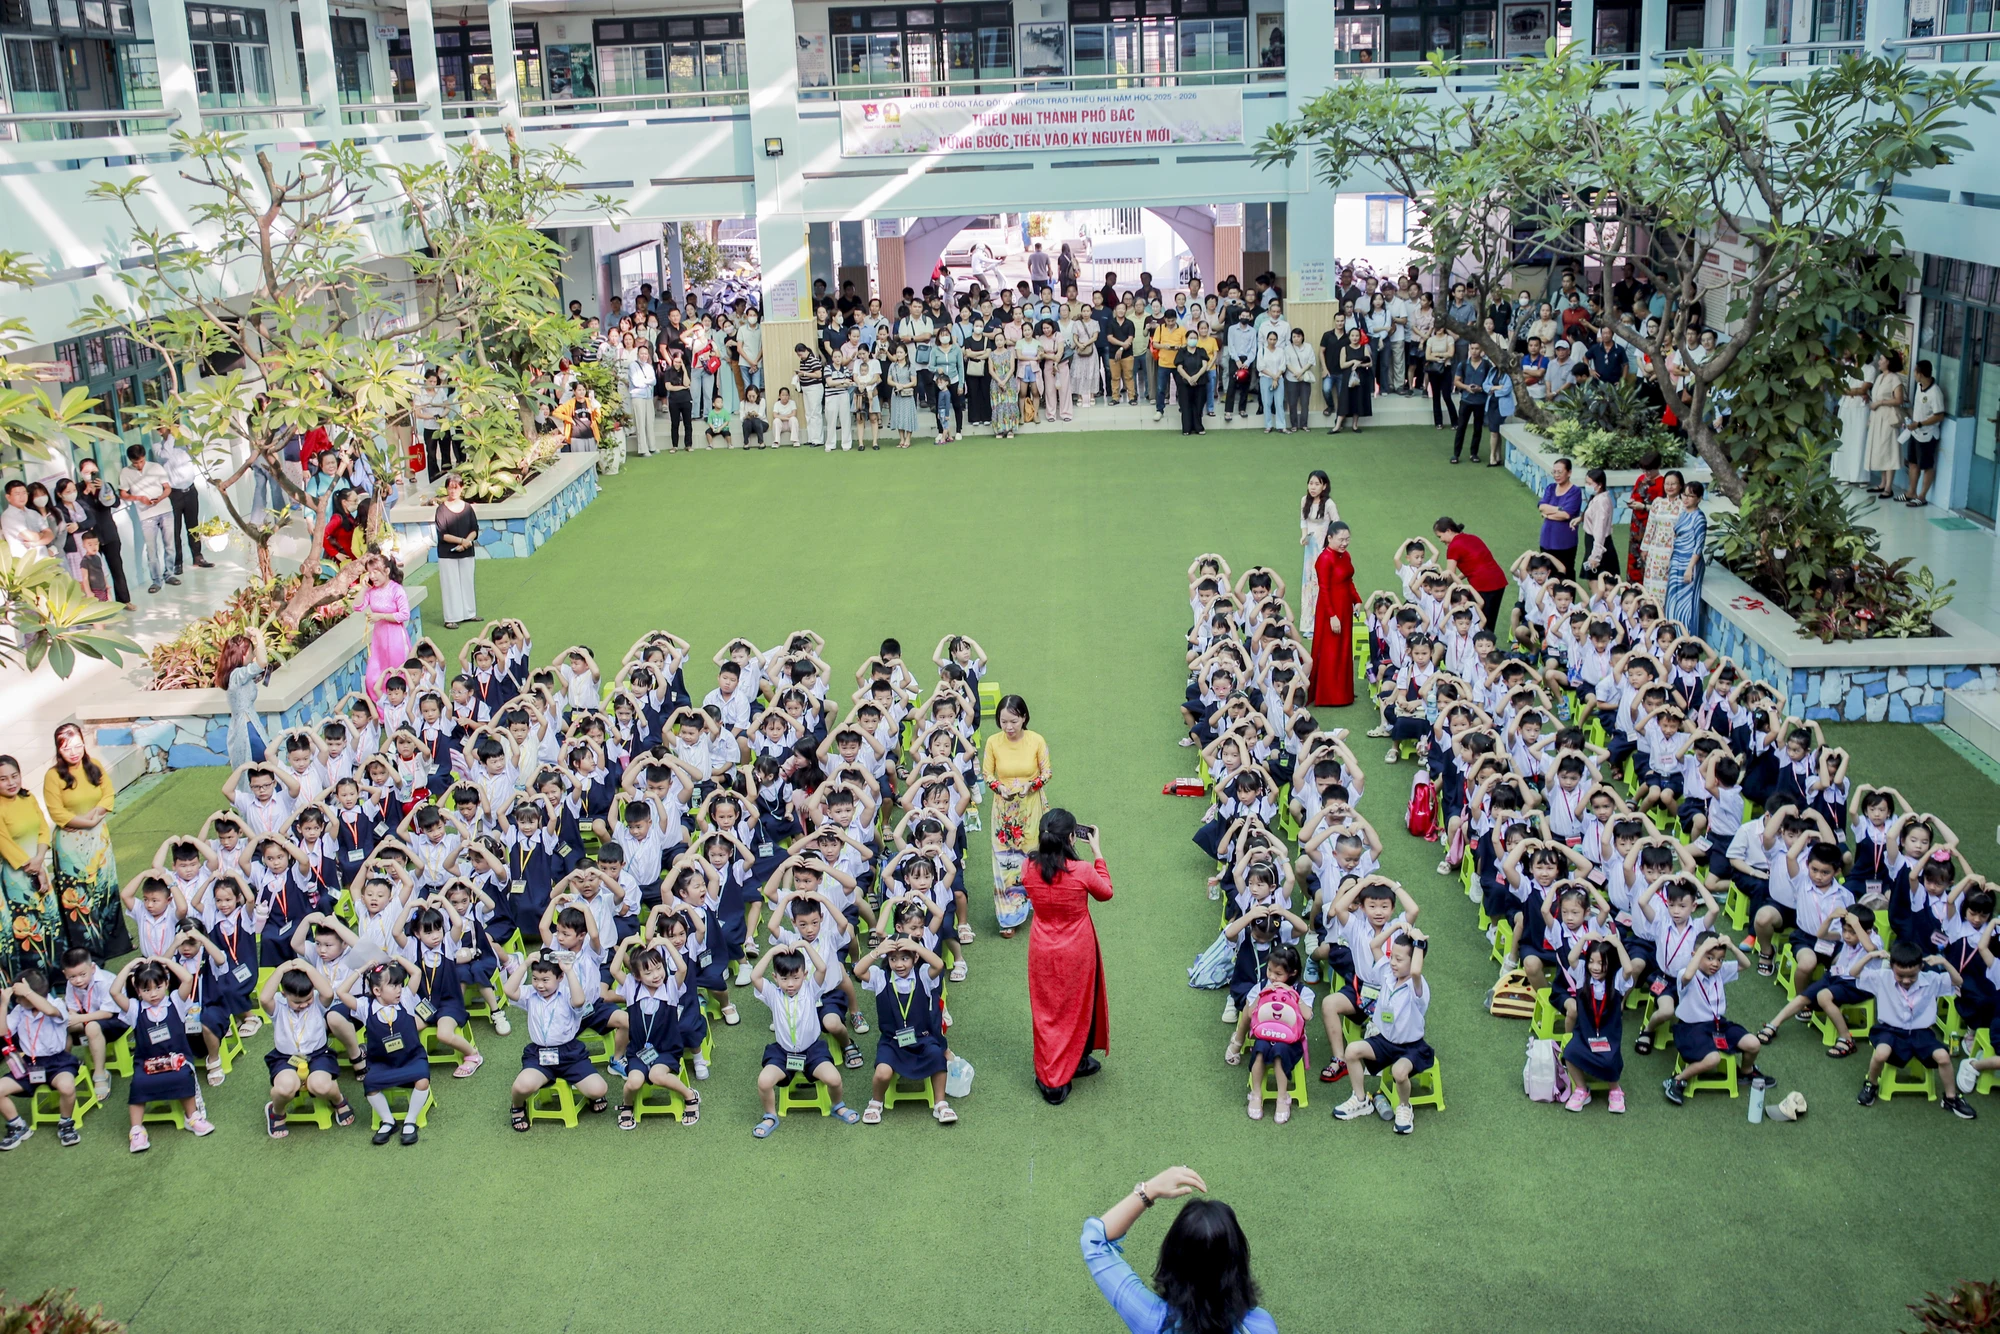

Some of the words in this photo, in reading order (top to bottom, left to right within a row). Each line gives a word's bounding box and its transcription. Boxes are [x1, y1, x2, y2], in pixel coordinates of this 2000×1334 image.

[942, 98, 966, 109] CÔNG
[968, 97, 984, 108] TÁC
[1015, 96, 1044, 107] PHONG
[1047, 95, 1070, 105] TRÀO
[1071, 93, 1095, 104] THIẾU
[1097, 95, 1111, 104] NHI
[1113, 92, 1132, 103] NĂM
[1134, 93, 1151, 103] HỌC
[1153, 92, 1172, 101] 2025
[1179, 91, 1197, 101] 2026
[972, 110, 1007, 126] THIẾU
[1011, 110, 1033, 125] NHI
[1036, 108, 1076, 125] THÀNH
[1081, 105, 1106, 123] PHỐ
[1110, 107, 1135, 121] BÁC
[938, 131, 972, 149] VỮNG
[976, 131, 1011, 149] BƯỚC
[1013, 128, 1041, 147] TIẾN
[1045, 129, 1069, 146] VÀO
[1072, 129, 1089, 145] KỶ
[1093, 128, 1142, 143] NGUYÊN
[1146, 127, 1171, 142] MỚI
[1261, 1029, 1286, 1039] LOTSO
